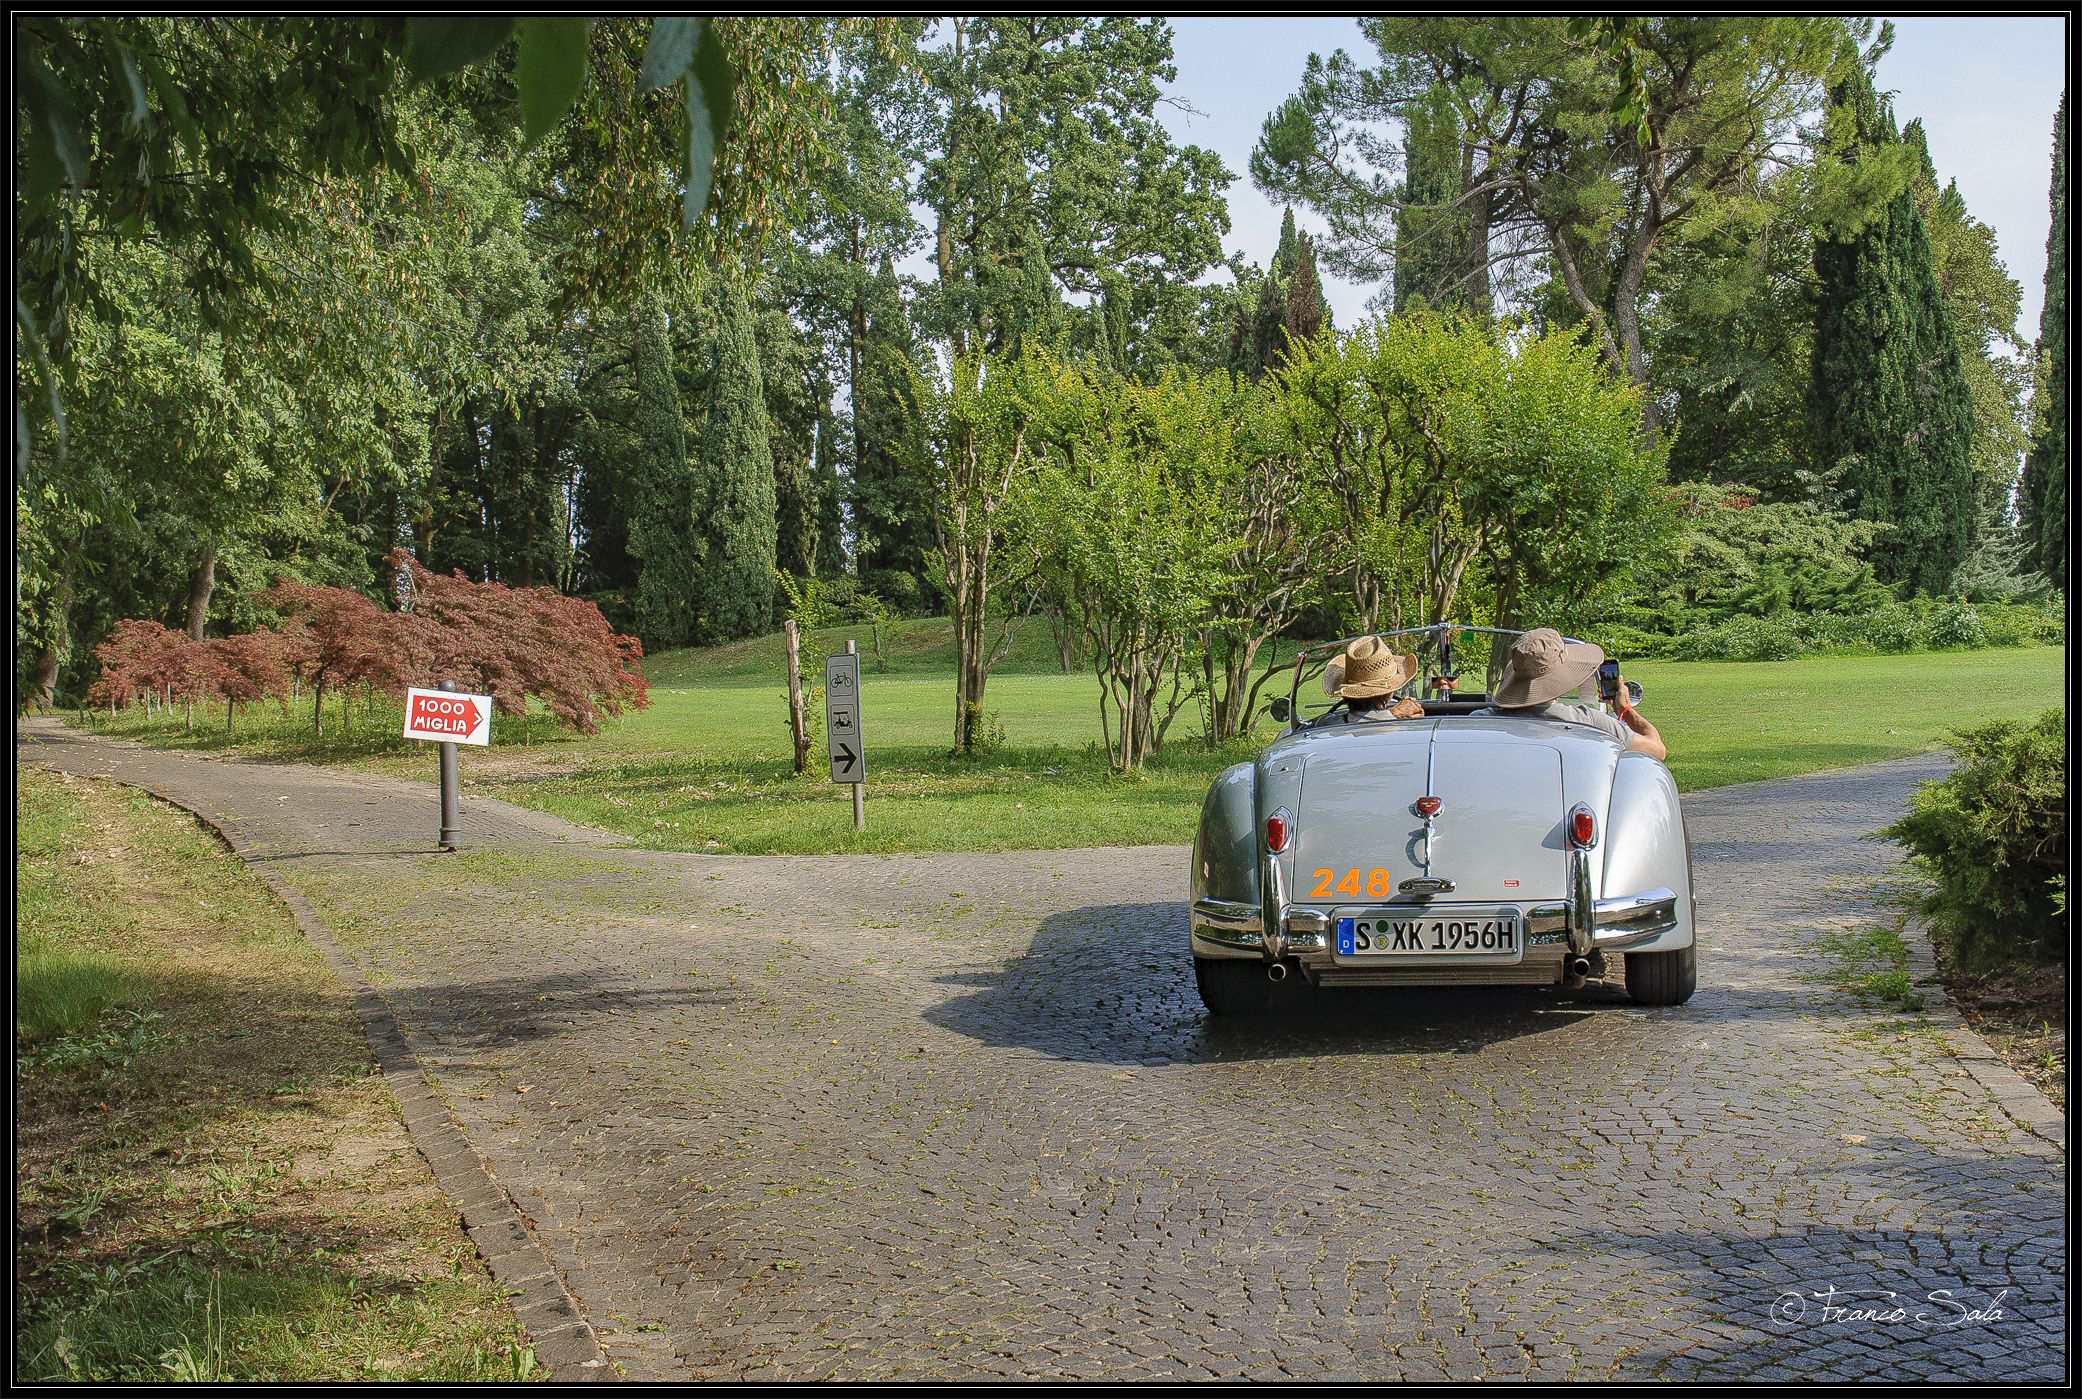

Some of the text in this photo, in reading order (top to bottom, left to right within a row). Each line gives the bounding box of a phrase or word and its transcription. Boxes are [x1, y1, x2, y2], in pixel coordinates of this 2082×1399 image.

[419, 699, 465, 715] 1000
[413, 715, 467, 732] MIGLIA
[1309, 867, 1390, 897] 248
[1342, 939, 1349, 948] D
[1355, 920, 1514, 950] S XK 1956H
